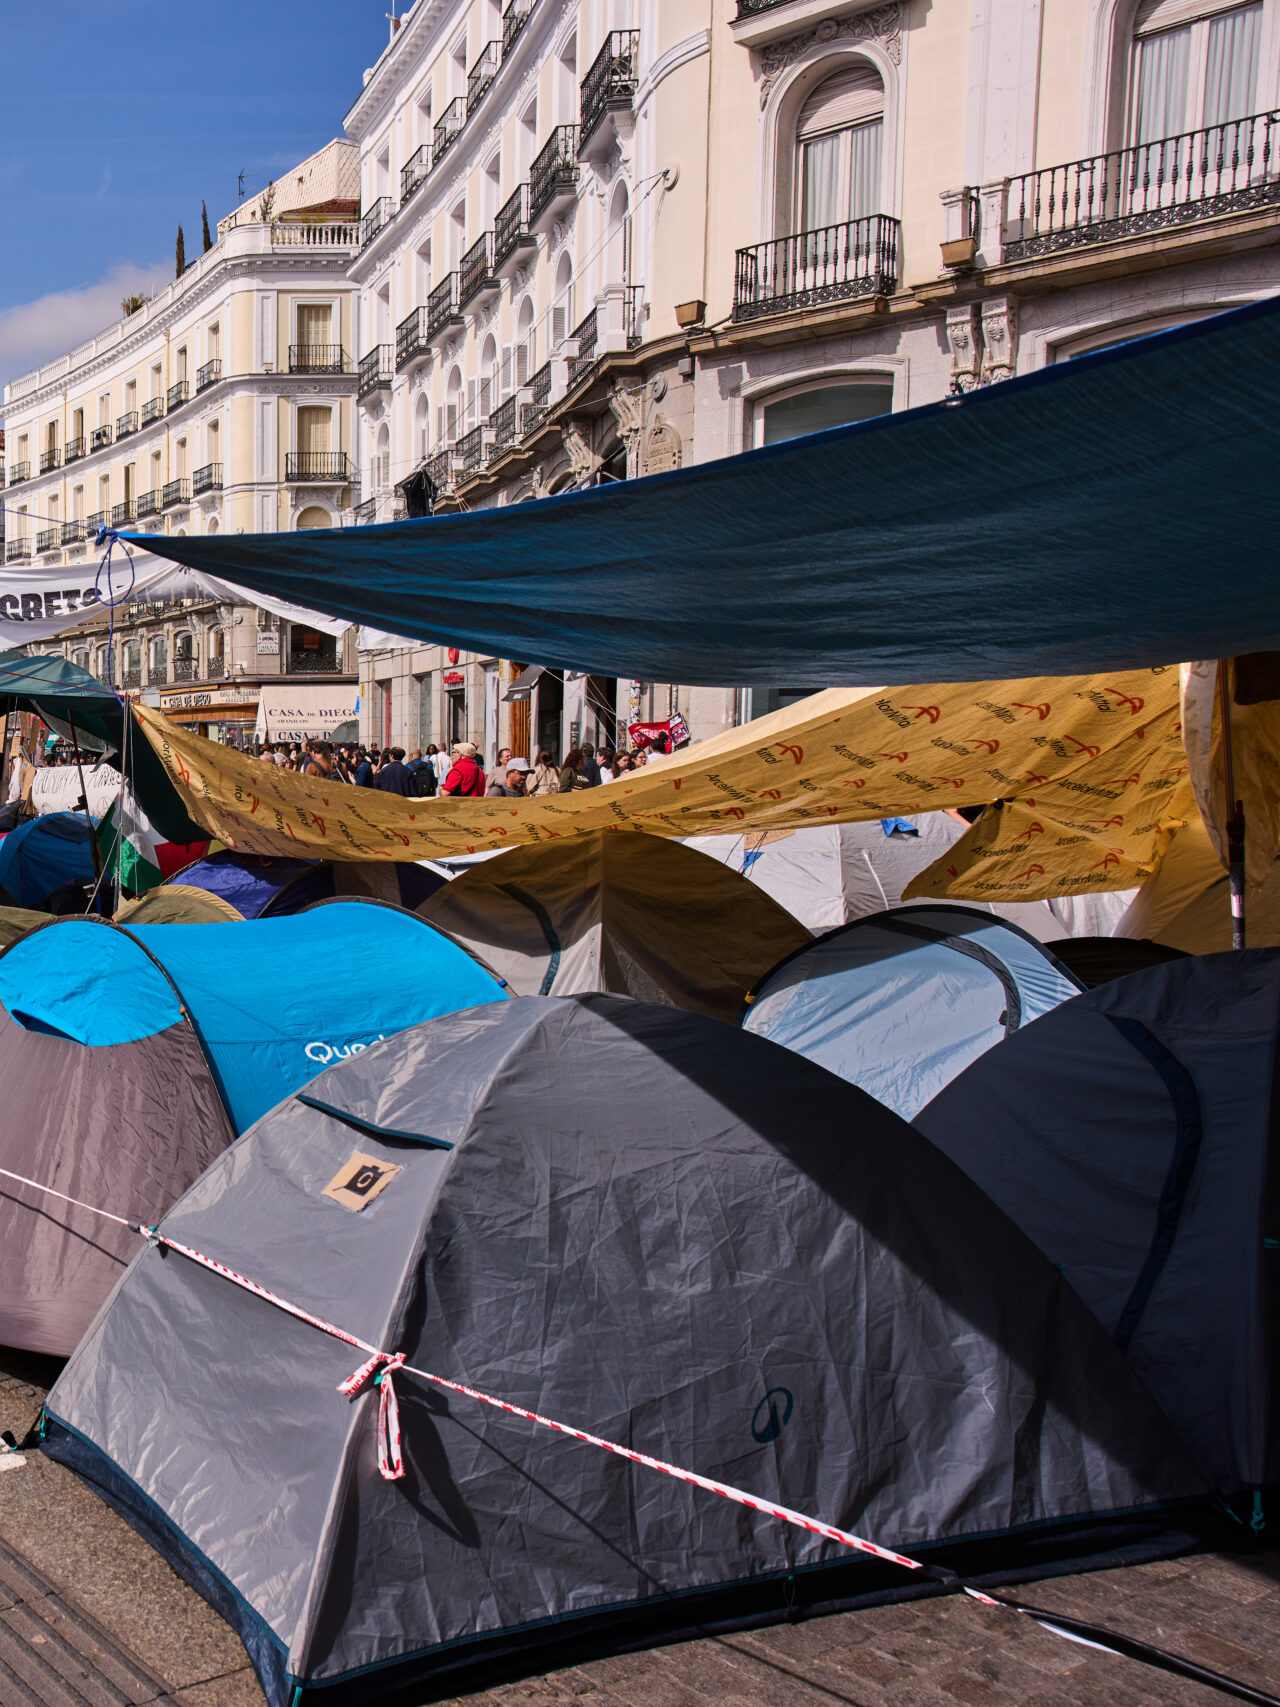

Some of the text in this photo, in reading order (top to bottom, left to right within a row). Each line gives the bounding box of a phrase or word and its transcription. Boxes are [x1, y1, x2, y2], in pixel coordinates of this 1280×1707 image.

[268, 708, 305, 717] CASA
[278, 731, 309, 741] CASA
[1057, 778, 1124, 800] ArcelorMittal
